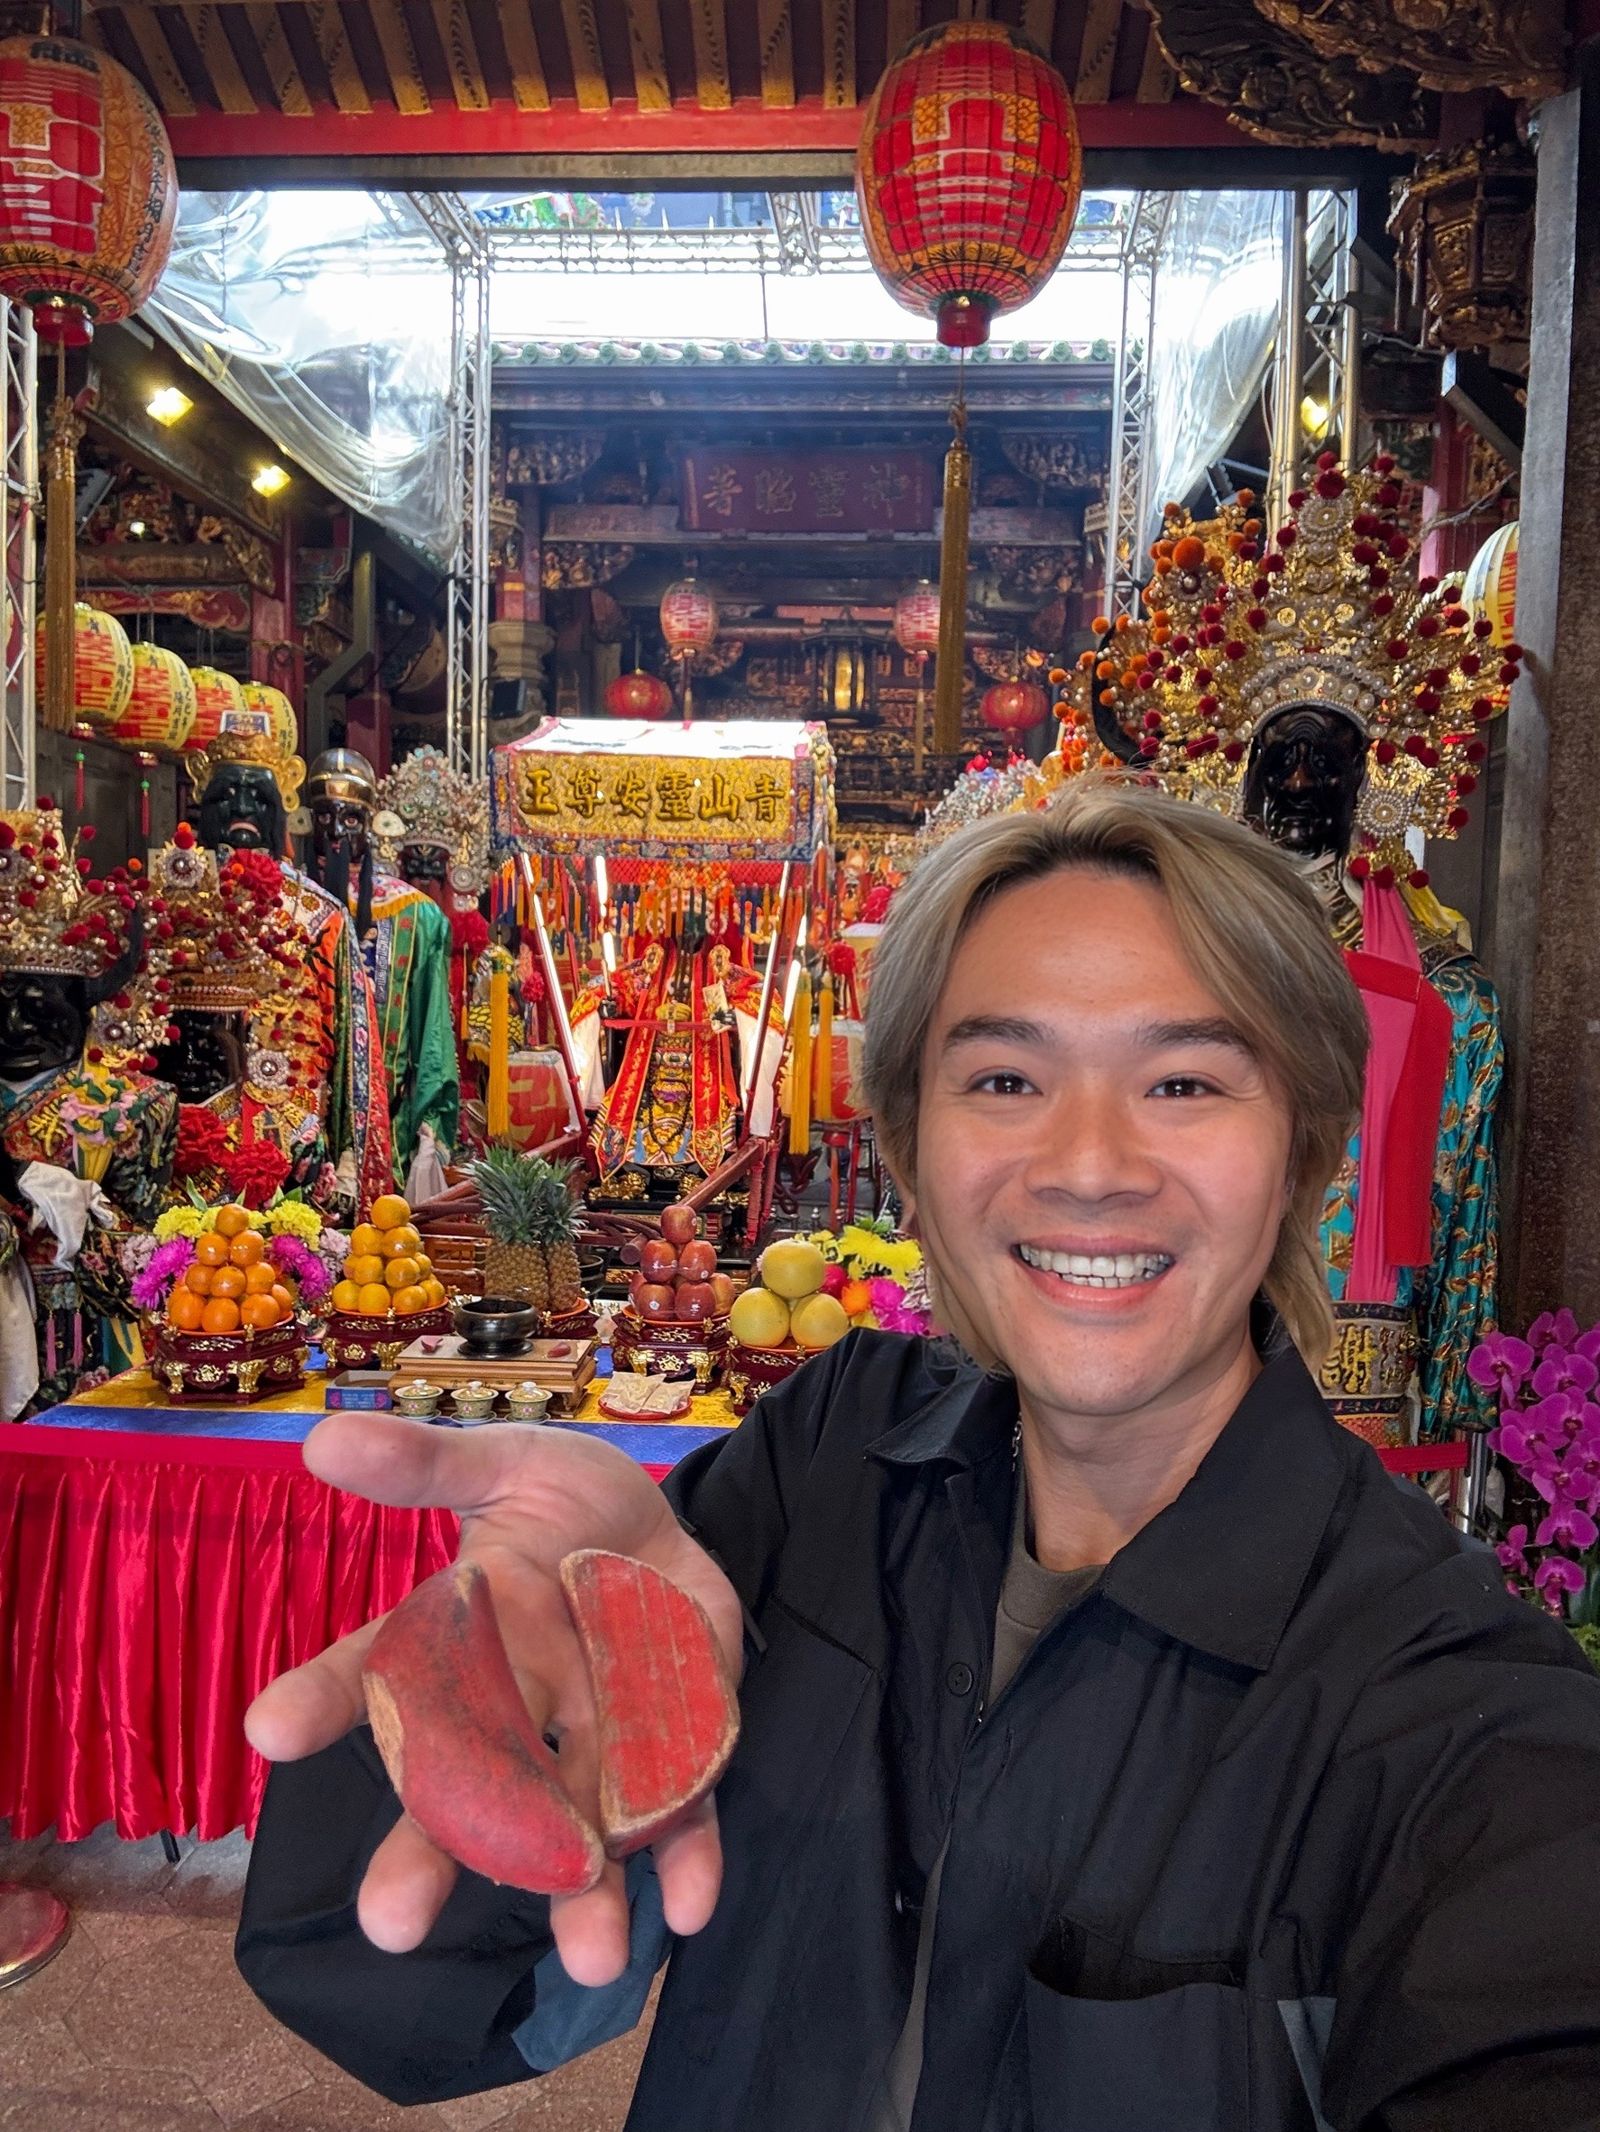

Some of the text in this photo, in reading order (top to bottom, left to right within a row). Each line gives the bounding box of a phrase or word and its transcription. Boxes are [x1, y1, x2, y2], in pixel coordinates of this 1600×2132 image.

[519, 767, 787, 823] 青山靈安尊王
